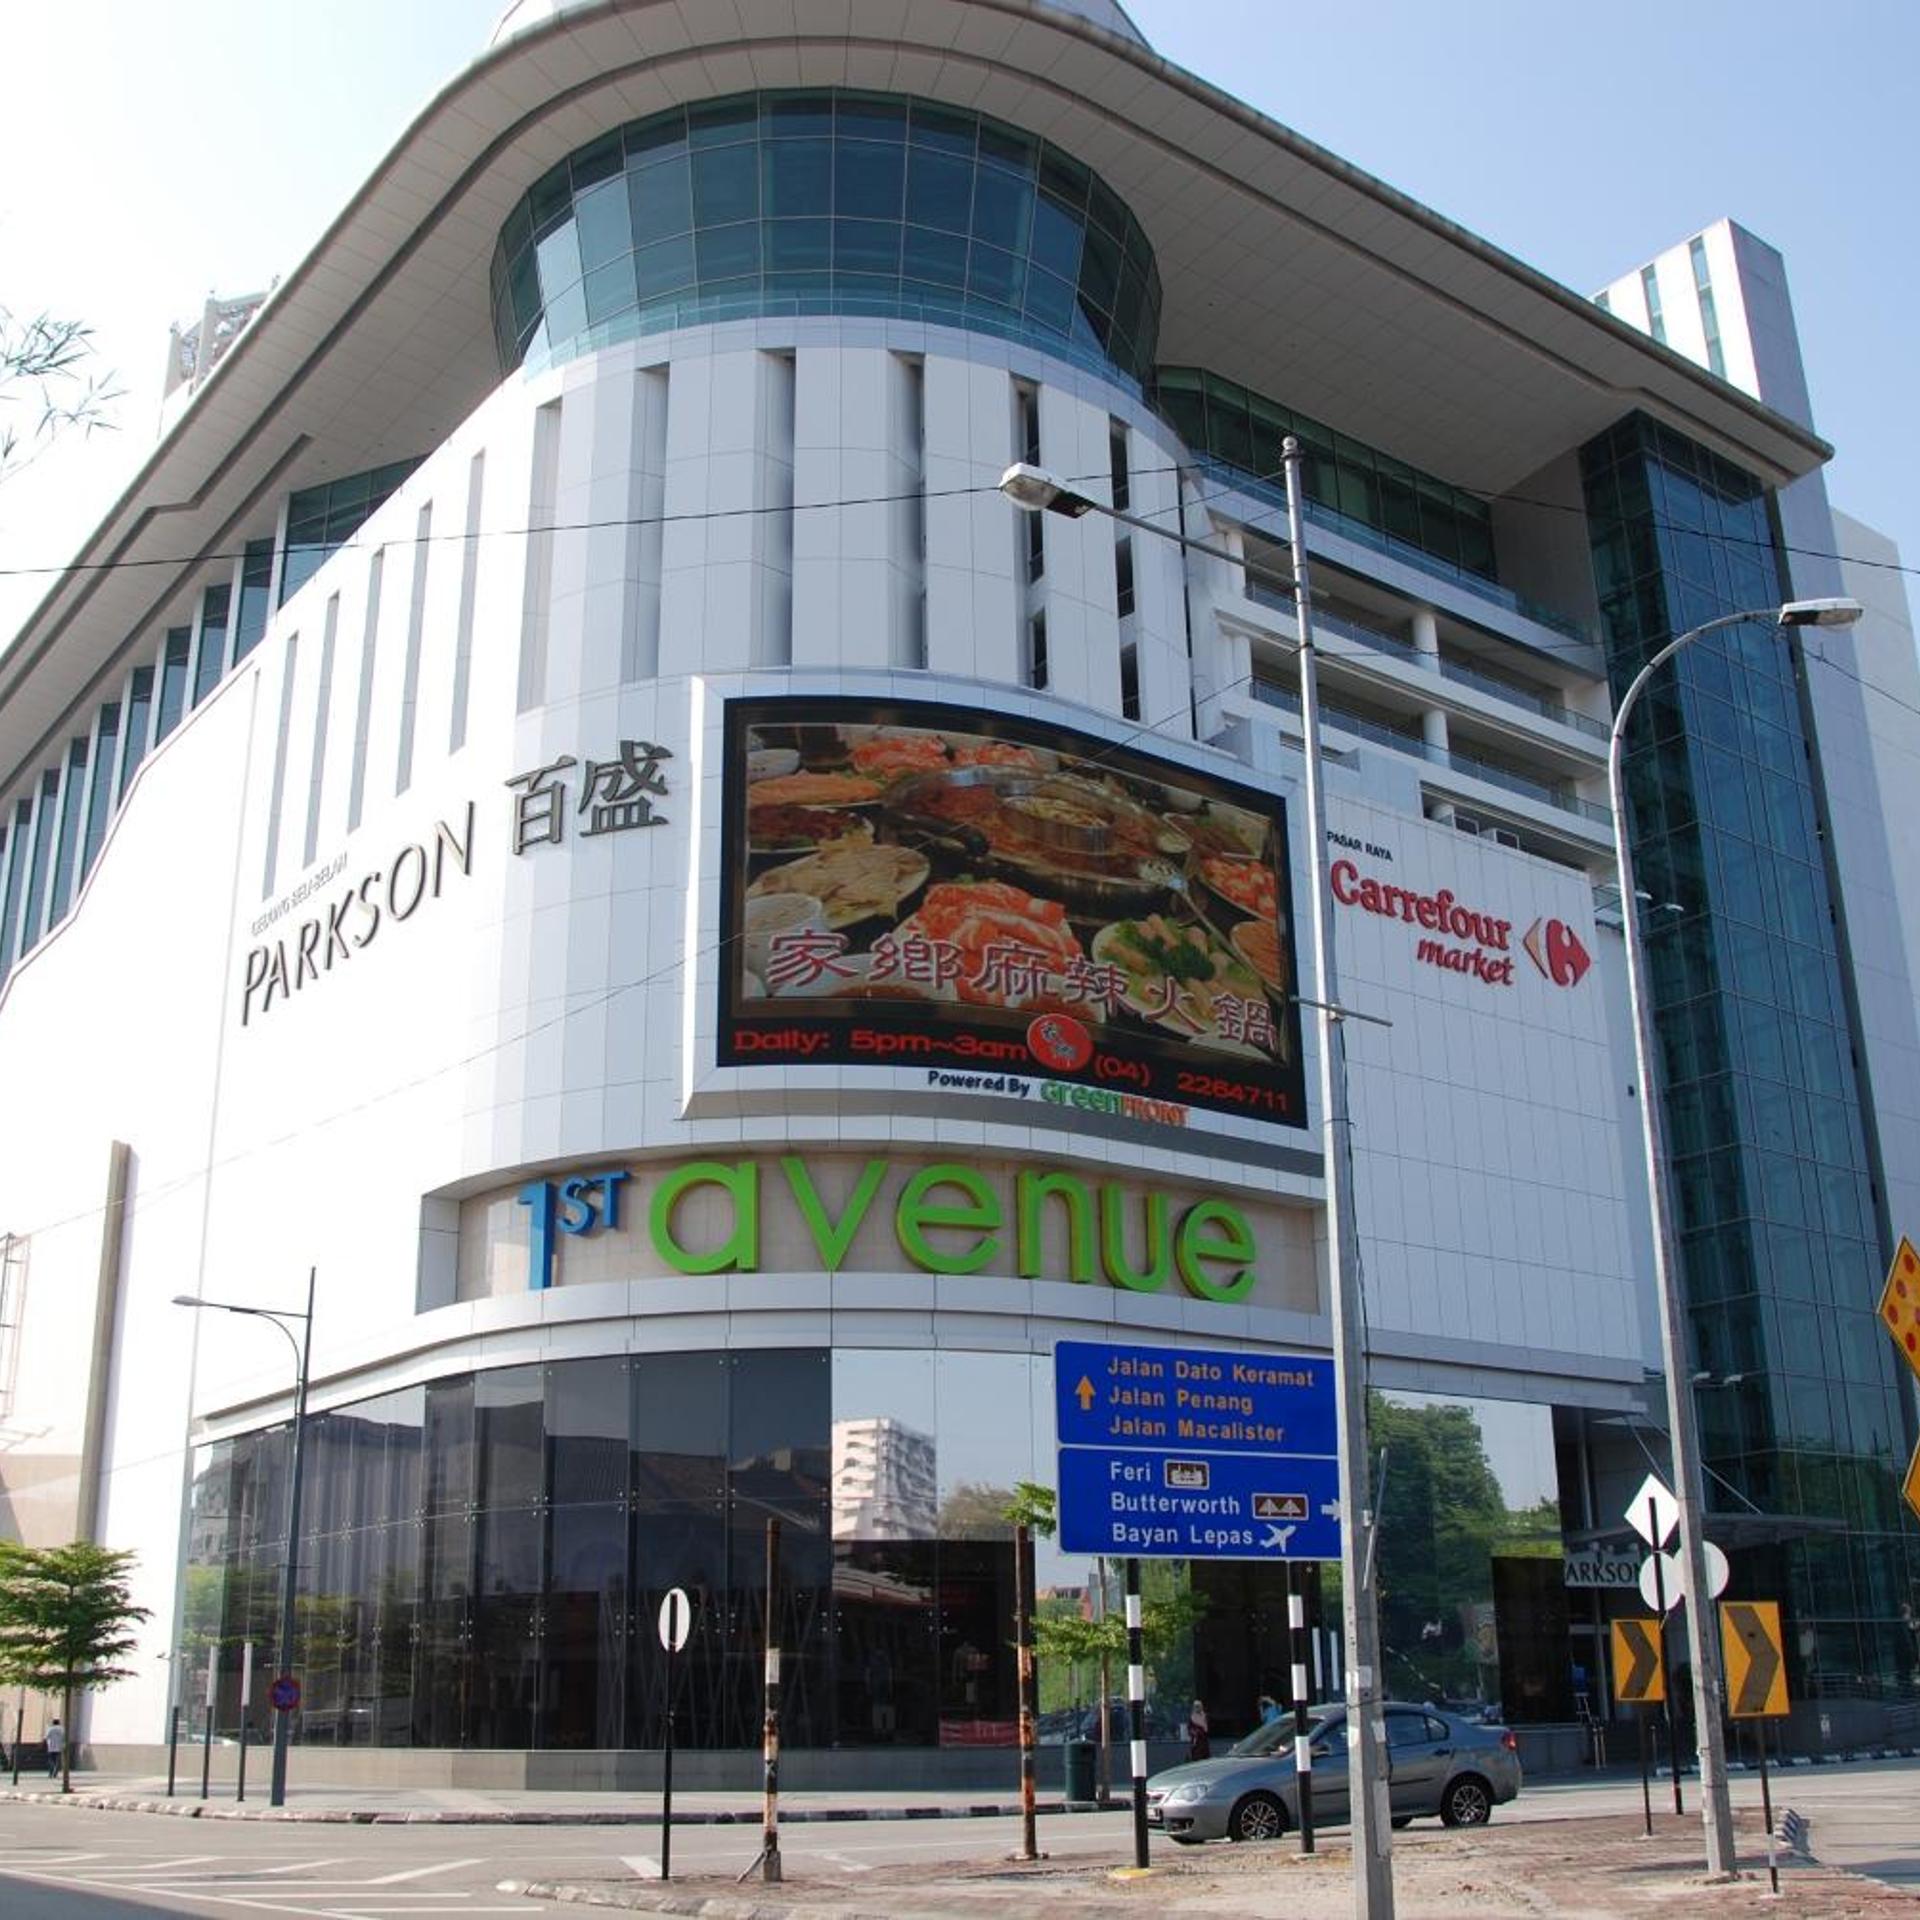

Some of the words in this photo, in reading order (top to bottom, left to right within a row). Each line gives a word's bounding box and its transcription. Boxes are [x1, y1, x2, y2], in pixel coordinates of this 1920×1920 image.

[505, 740, 674, 856] 百盛
[1327, 831, 1363, 852] PASAR
[1366, 843, 1393, 862] RAYA
[242, 801, 475, 1027] PARKSON
[1330, 859, 1512, 951] Carrefour
[1417, 939, 1515, 986] market
[734, 1030, 831, 1055] Daily:
[1094, 1055, 1150, 1087] (04)
[928, 1070, 1005, 1091] Powered
[1009, 1078, 1030, 1097] By
[518, 1169, 632, 1290] 1ST
[649, 1156, 1257, 1302] avenue
[1107, 1357, 1164, 1377] Jalan
[1175, 1360, 1222, 1380] Dato
[1233, 1364, 1315, 1388] Keramat
[1108, 1387, 1165, 1406] Jalan
[1177, 1390, 1253, 1416] Penang
[1109, 1416, 1166, 1436] Jalan
[1178, 1419, 1284, 1442] Macalister
[1110, 1461, 1151, 1481] Feri
[1110, 1492, 1241, 1515] Butterworth
[1112, 1523, 1178, 1547] Bayan
[1190, 1525, 1253, 1548] Lepas
